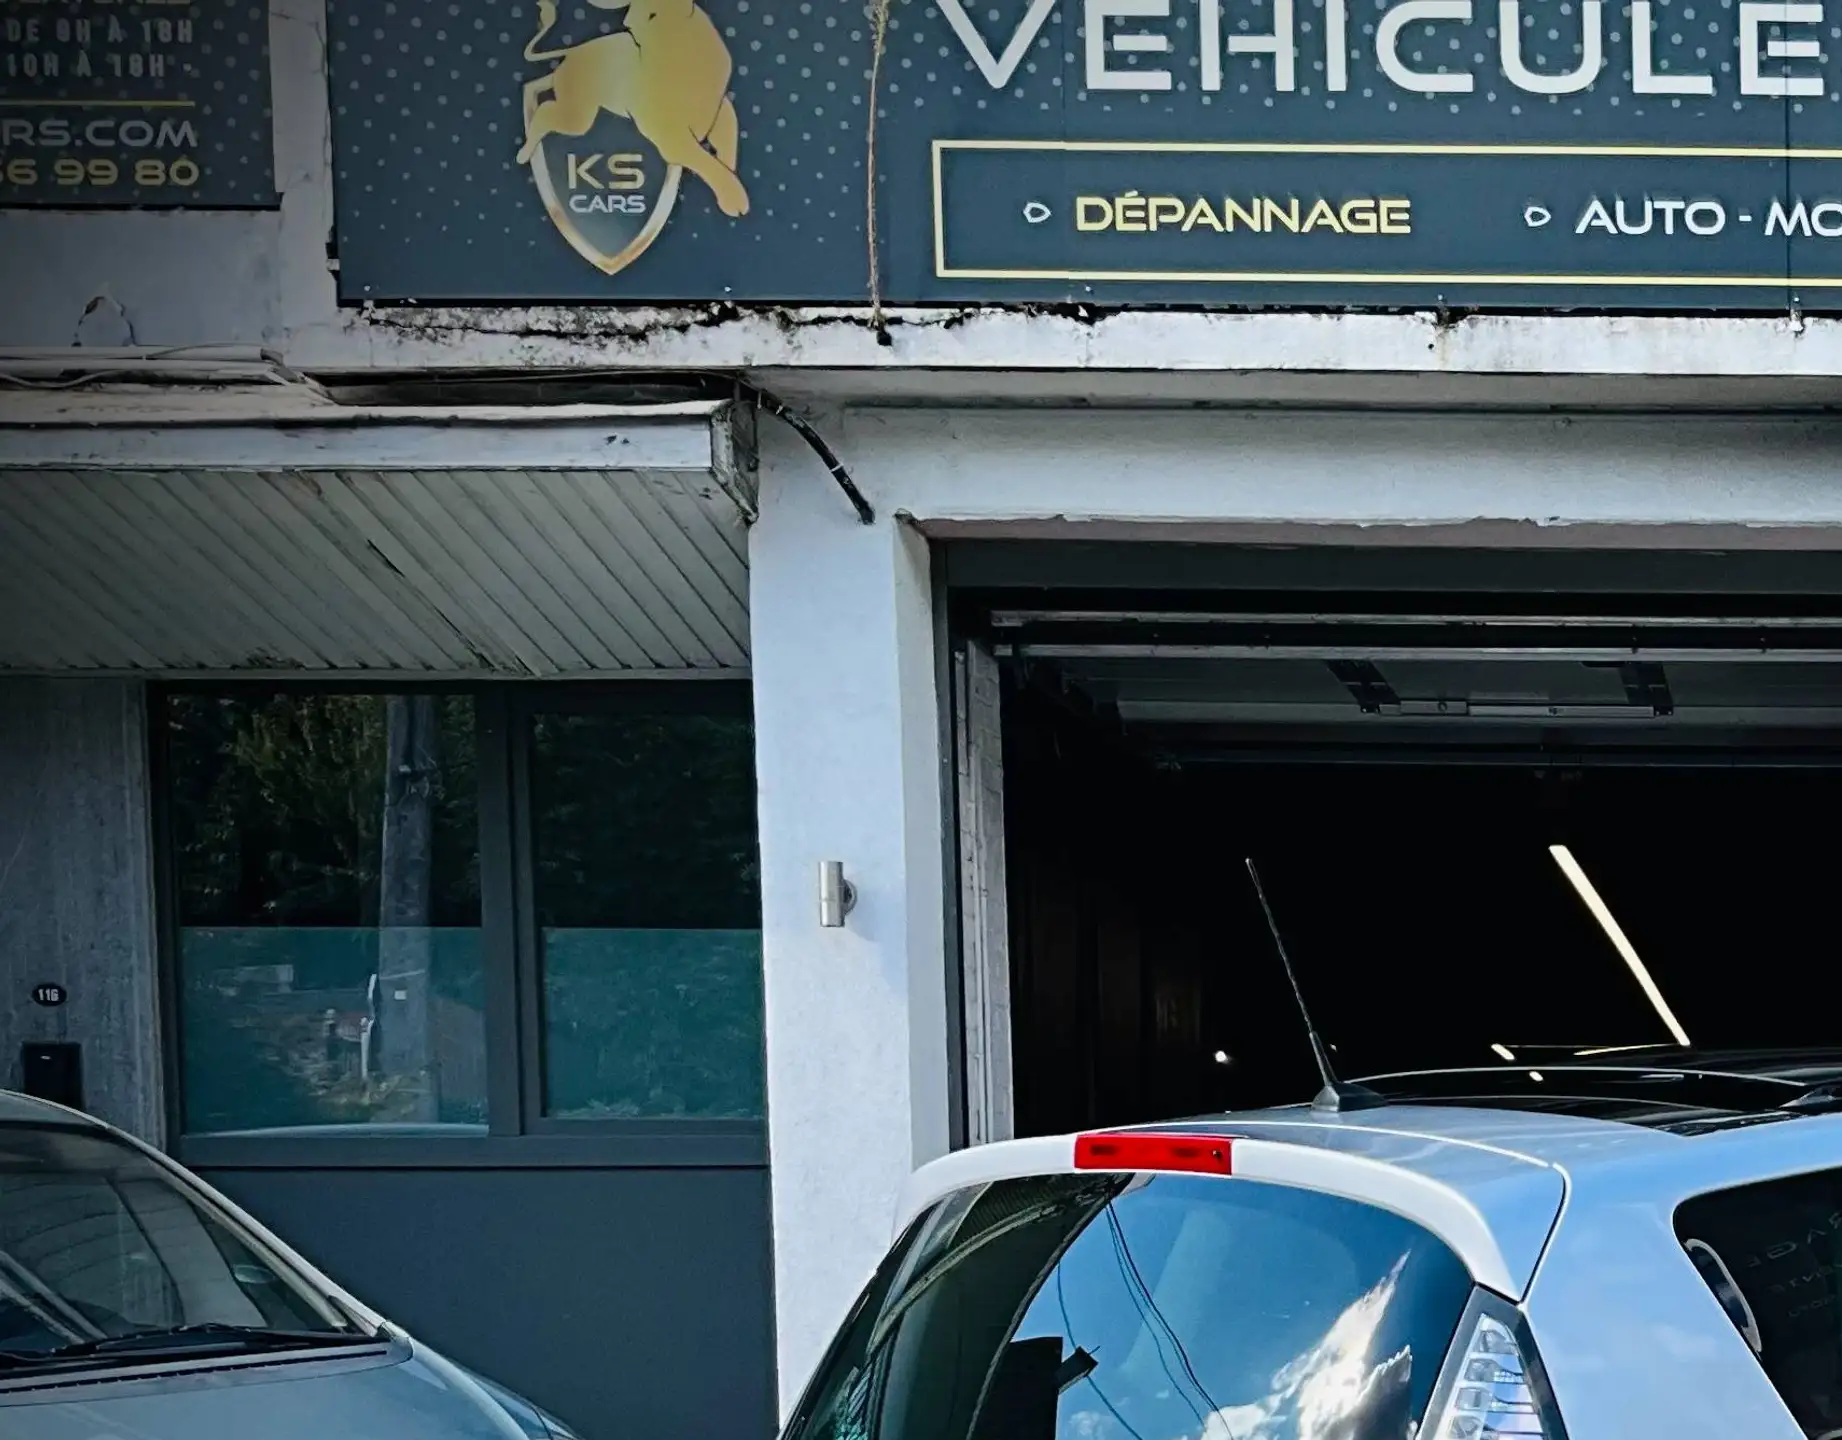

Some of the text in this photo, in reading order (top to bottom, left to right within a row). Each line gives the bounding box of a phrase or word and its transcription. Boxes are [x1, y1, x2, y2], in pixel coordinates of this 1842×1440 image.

[0, 158, 200, 187] 6 99 80
[566, 152, 645, 190] KS
[569, 193, 647, 214] CARS
[1076, 190, 1411, 234] DÉPANNAGE
[1575, 197, 1726, 235] AUTO
